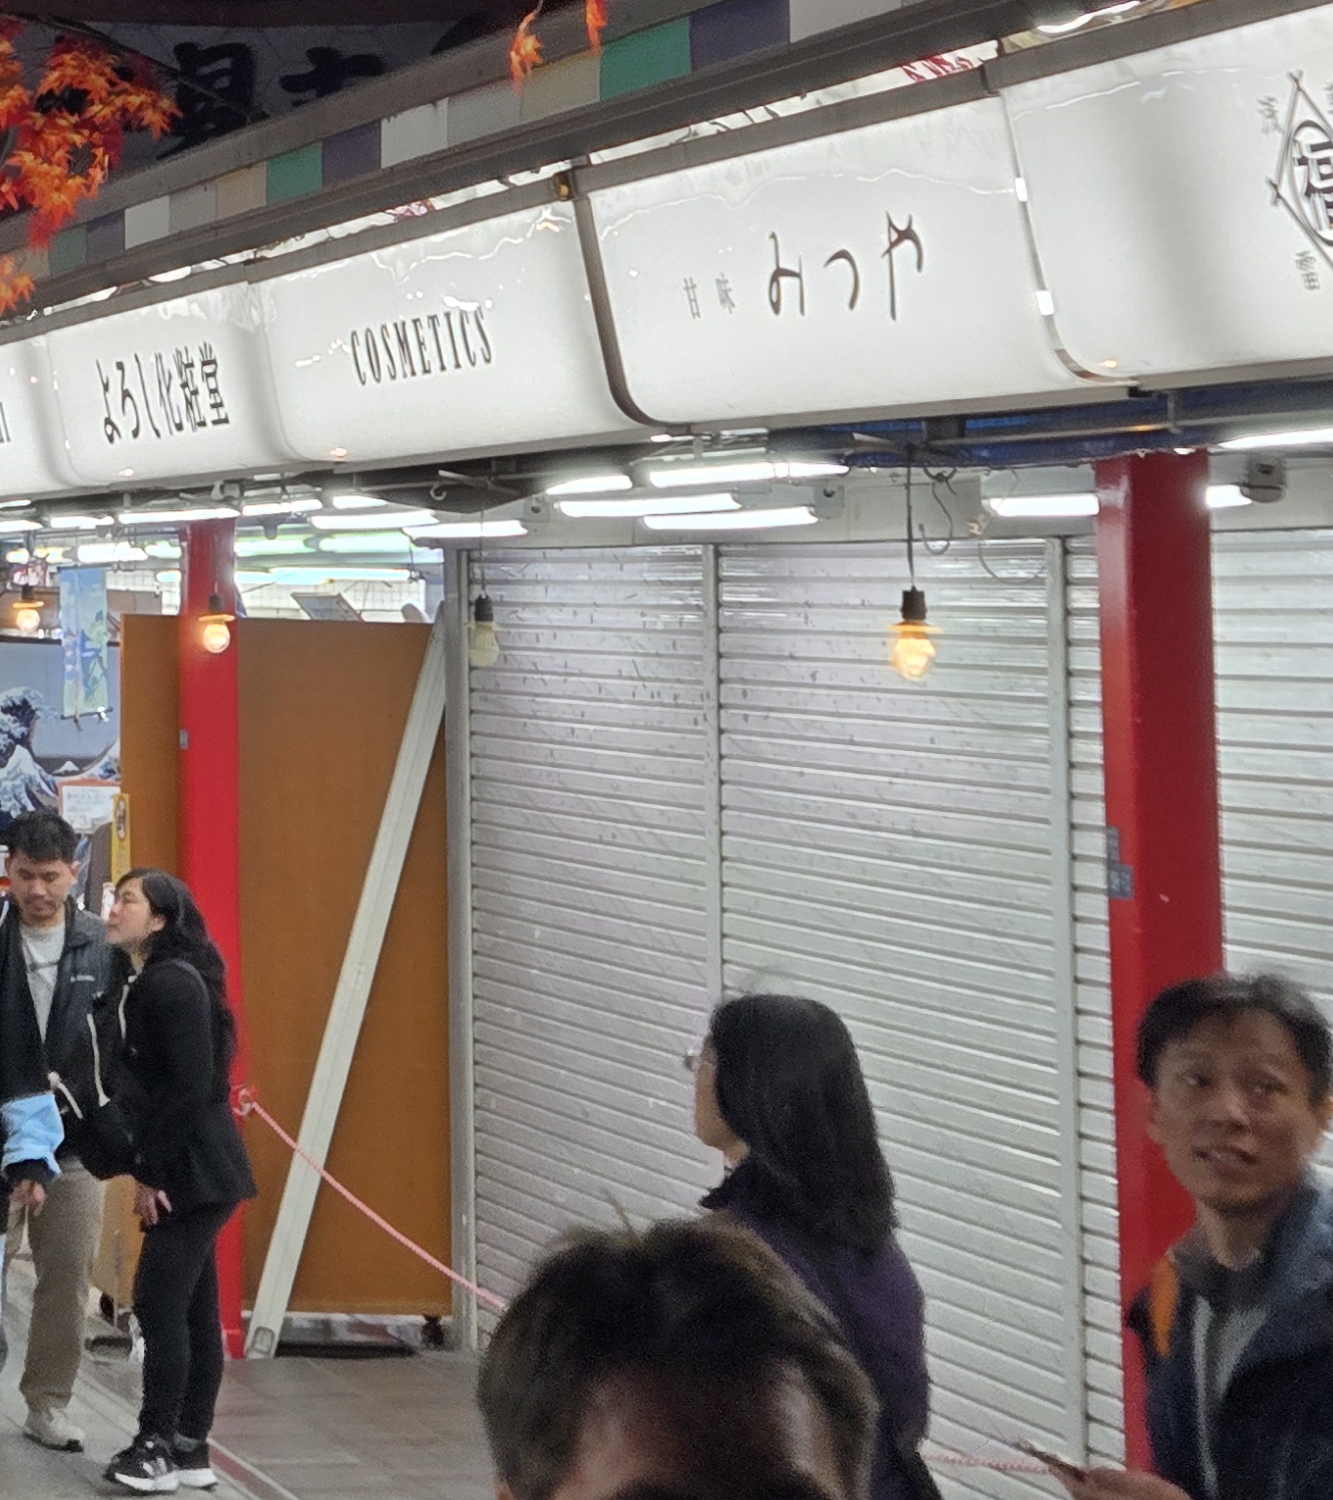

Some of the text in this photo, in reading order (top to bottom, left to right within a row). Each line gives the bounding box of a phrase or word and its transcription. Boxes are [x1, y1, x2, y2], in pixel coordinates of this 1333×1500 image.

[683, 210, 924, 321] 甘味 みつや
[95, 341, 230, 445] よろし化粧堂
[350, 306, 492, 386] COSMETICS
